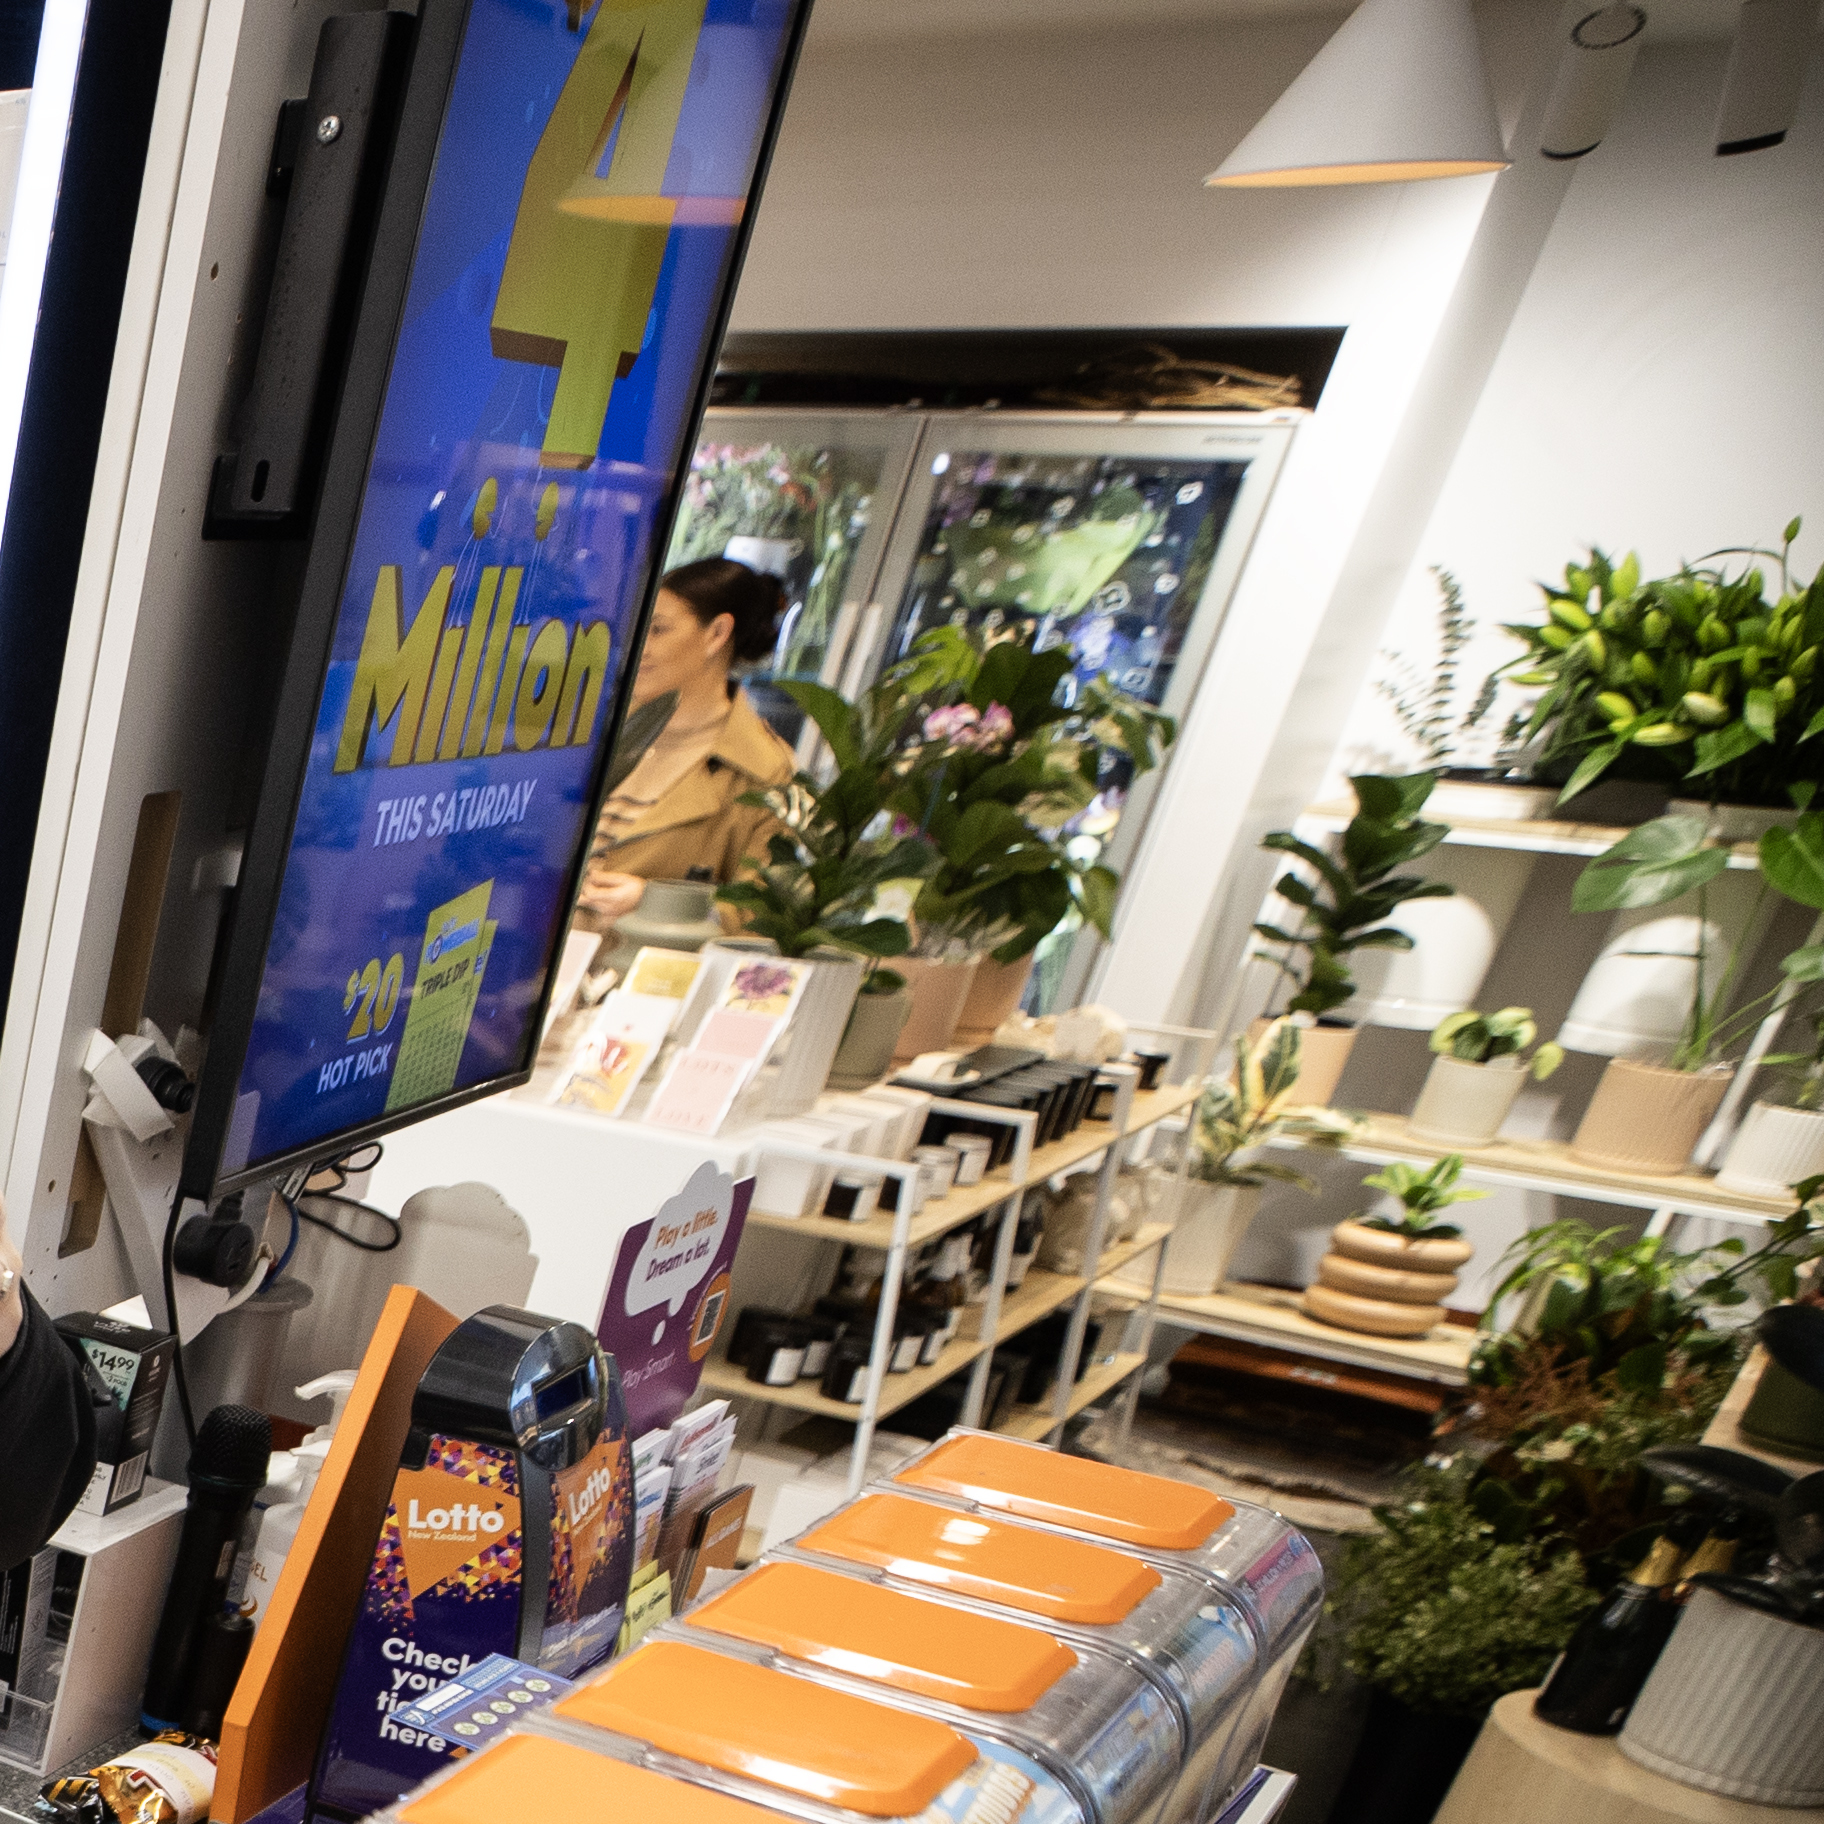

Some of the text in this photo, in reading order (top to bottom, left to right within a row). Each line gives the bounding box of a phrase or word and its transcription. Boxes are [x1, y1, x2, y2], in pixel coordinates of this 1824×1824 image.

[333, 564, 611, 775] Million
[373, 779, 538, 848] THIS SATURDAY
[343, 951, 404, 1045] $20
[421, 958, 470, 1000] TRIPLE DIP
[316, 1042, 393, 1094] HOT PICK
[654, 1224, 681, 1249] Play
[691, 1206, 718, 1234] little.
[645, 1252, 682, 1282] Dream
[693, 1236, 710, 1260] lot.
[408, 1498, 505, 1533] Lotto
[568, 1466, 611, 1527] Lotto
[408, 1530, 477, 1542] New Zealand
[382, 1637, 477, 1676] Check
[392, 1668, 454, 1697] you
[379, 1716, 446, 1753] here
